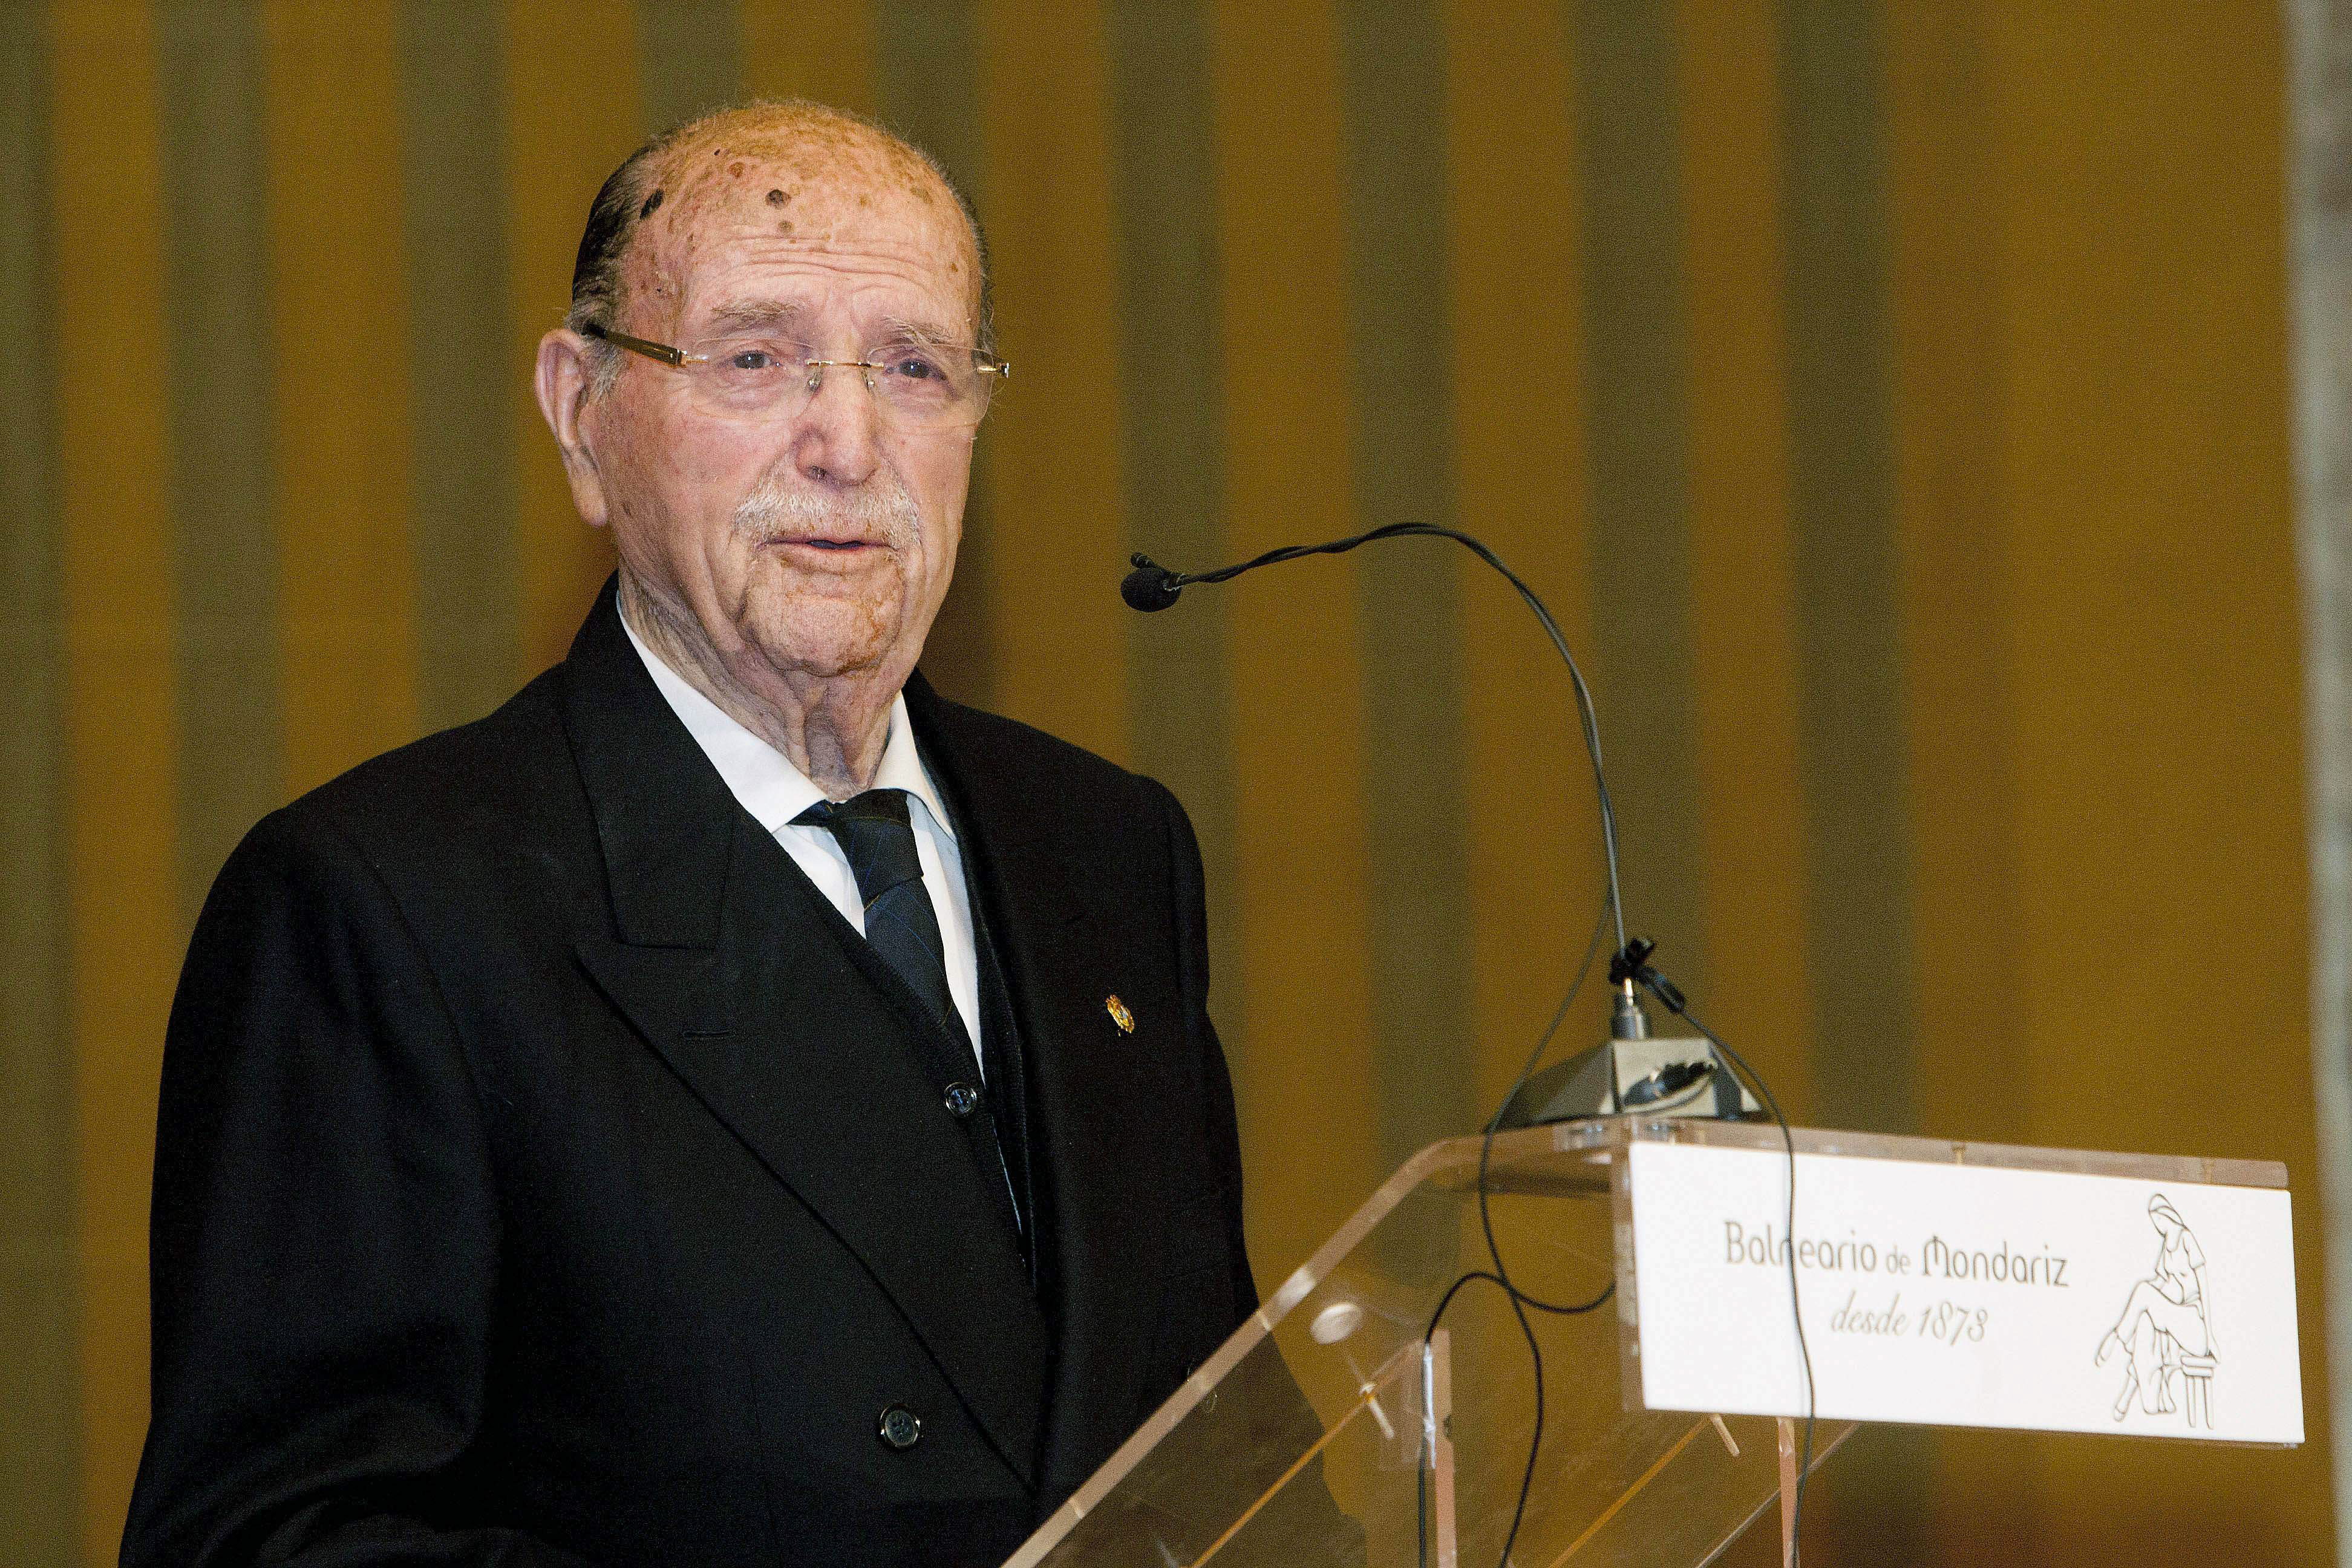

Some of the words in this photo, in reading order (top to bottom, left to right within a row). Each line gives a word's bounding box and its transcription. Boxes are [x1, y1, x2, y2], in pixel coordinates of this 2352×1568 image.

[1725, 1220, 1877, 1272] Balneario
[1886, 1244, 1910, 1274] de
[1922, 1235, 2069, 1287] Mondariz
[1831, 1289, 1908, 1336] desde
[1919, 1300, 1989, 1346] 1873
